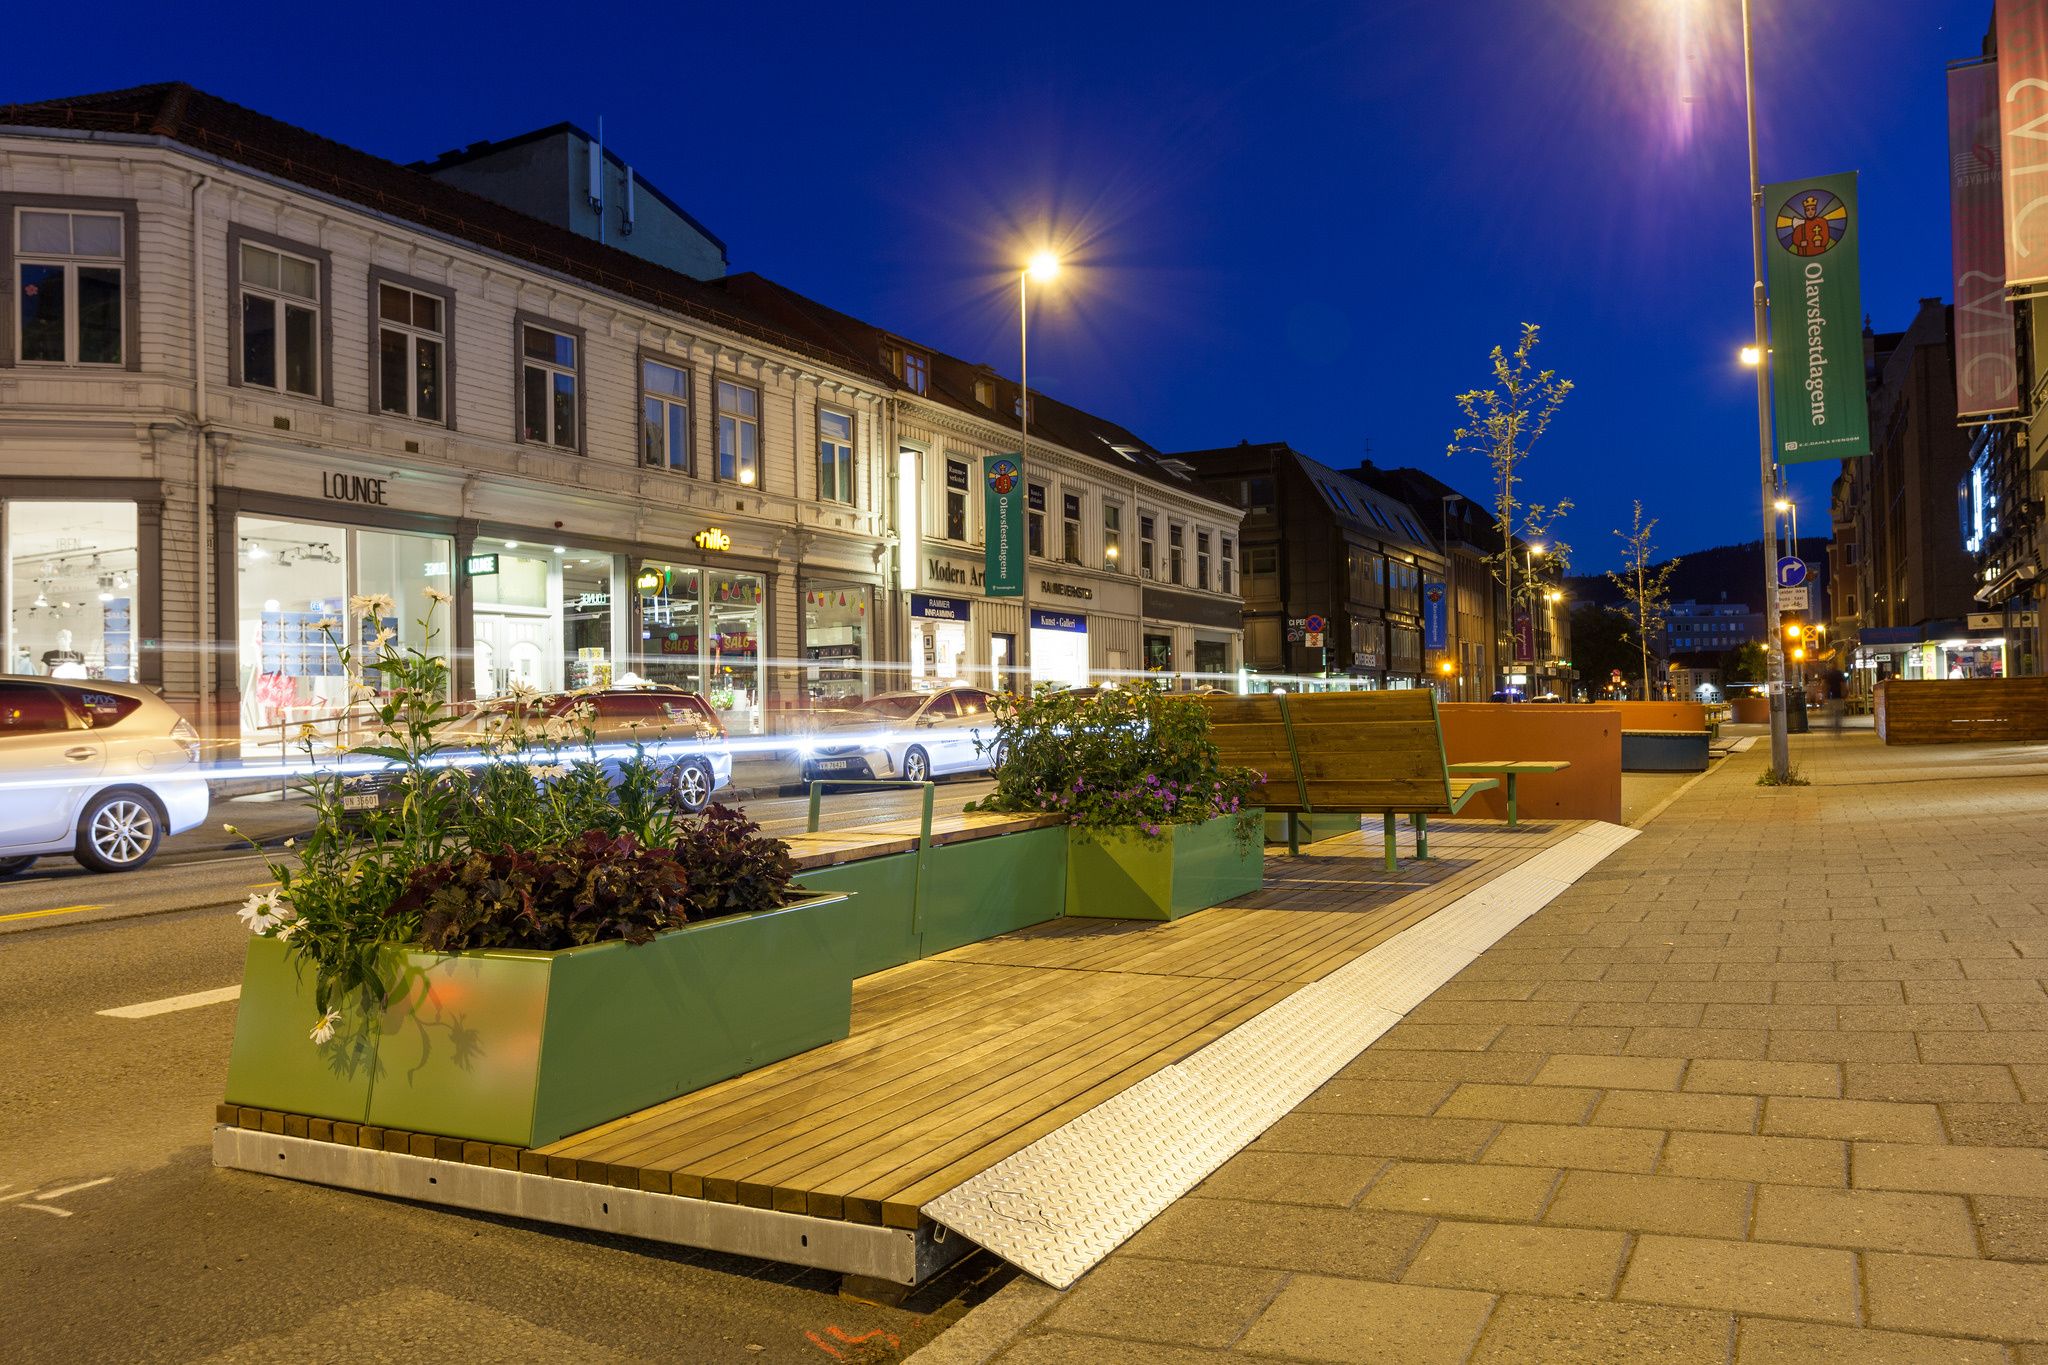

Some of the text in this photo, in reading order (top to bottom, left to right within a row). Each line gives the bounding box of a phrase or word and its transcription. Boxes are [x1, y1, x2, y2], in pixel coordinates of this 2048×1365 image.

[1805, 262, 1828, 426] Olavsfestdagene
[323, 471, 388, 506] LOUNGE
[696, 527, 731, 551] nille
[999, 497, 1009, 579] Olavsfestdagene
[468, 557, 495, 573] LOUNGE
[929, 558, 966, 586] Modern
[1041, 580, 1092, 600] RAMMEVERKSTED
[929, 599, 950, 608] RAMMER
[925, 608, 954, 619] INNRAMMING
[1041, 615, 1055, 626] Kunst
[1060, 616, 1076, 628] Galleri
[664, 641, 689, 651] SALG
[724, 636, 749, 649] SALG
